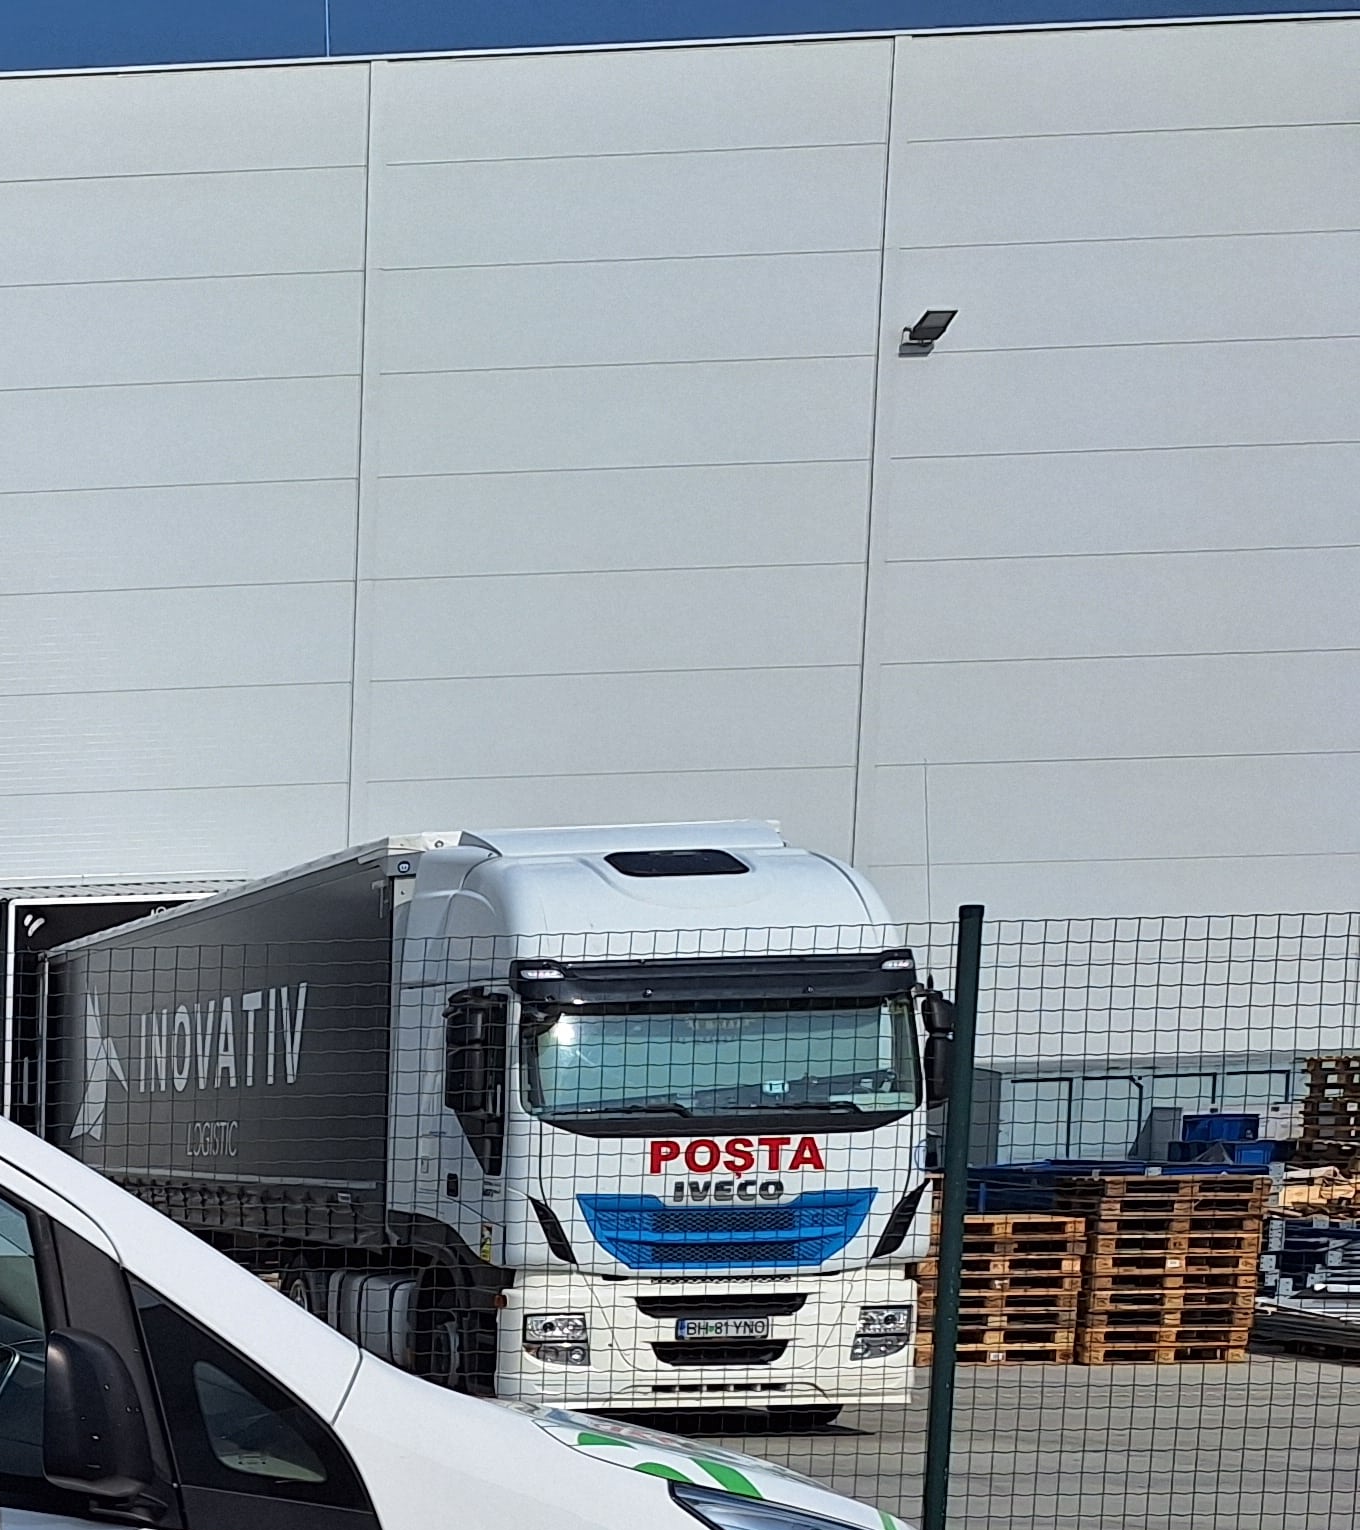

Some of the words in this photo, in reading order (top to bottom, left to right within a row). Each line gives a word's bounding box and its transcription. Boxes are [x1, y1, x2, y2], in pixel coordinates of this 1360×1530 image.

[139, 982, 308, 1093] INOVATIV
[186, 1121, 239, 1157] LOGISTIC
[673, 1180, 784, 1202] IVECO
[686, 1321, 708, 1336] BH
